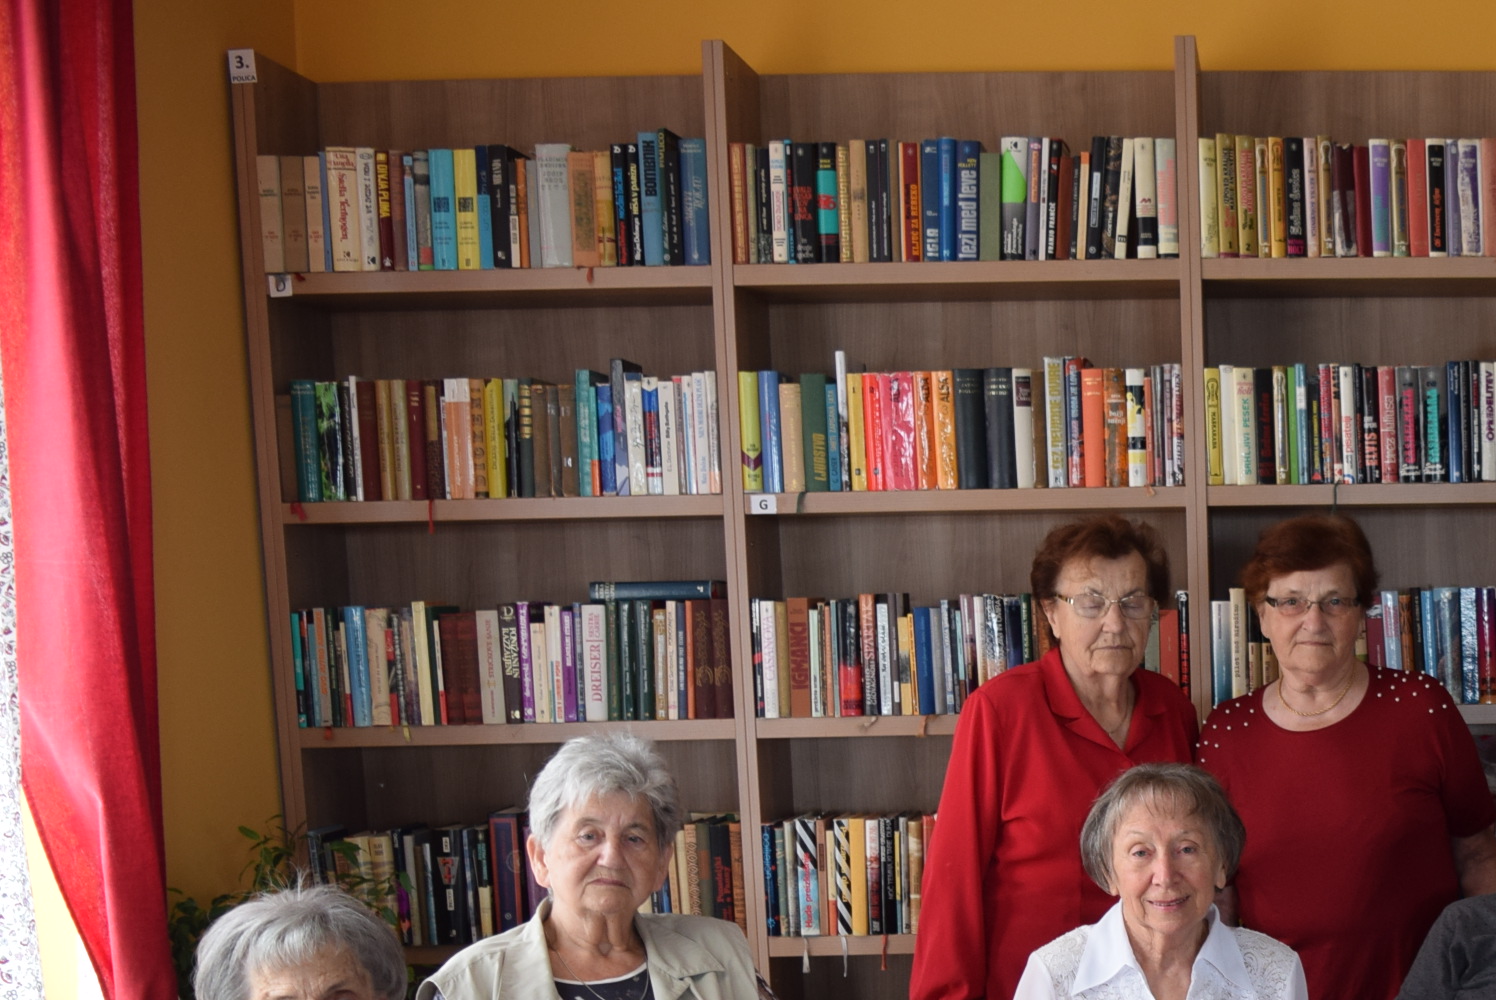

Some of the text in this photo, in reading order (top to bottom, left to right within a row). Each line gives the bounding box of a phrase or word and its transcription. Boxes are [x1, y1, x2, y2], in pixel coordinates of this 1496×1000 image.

[234, 55, 250, 69] 3.
[641, 139, 659, 197] BOMBNIK
[657, 131, 665, 168] PIMLICO
[376, 163, 391, 218] DIVJA PLIMA
[629, 162, 639, 191] PARIZU
[959, 170, 976, 197] leve
[630, 197, 640, 215] HIŠA
[909, 184, 920, 256] KLJUČ ZA REBEKO
[960, 199, 977, 230] med
[926, 228, 940, 258] IGLA
[1047, 229, 1056, 255] FRANJO
[1240, 398, 1250, 429] PESEK
[1484, 371, 1496, 442] OPREDELITEV
[1210, 411, 1219, 449] MASKARADA
[1382, 395, 1397, 464] brez Juliusa
[812, 433, 827, 482] LJUDSTVO
[758, 499, 768, 510] G
[587, 612, 595, 638] SESTRA
[861, 602, 874, 660] SPARTAK
[508, 627, 520, 679] PONIŽANI IN
[763, 615, 775, 682] CASANOVA
[789, 622, 810, 690] IGMANCI
[589, 644, 604, 703] DREISER
[801, 852, 814, 929] Hude preizkušnje
